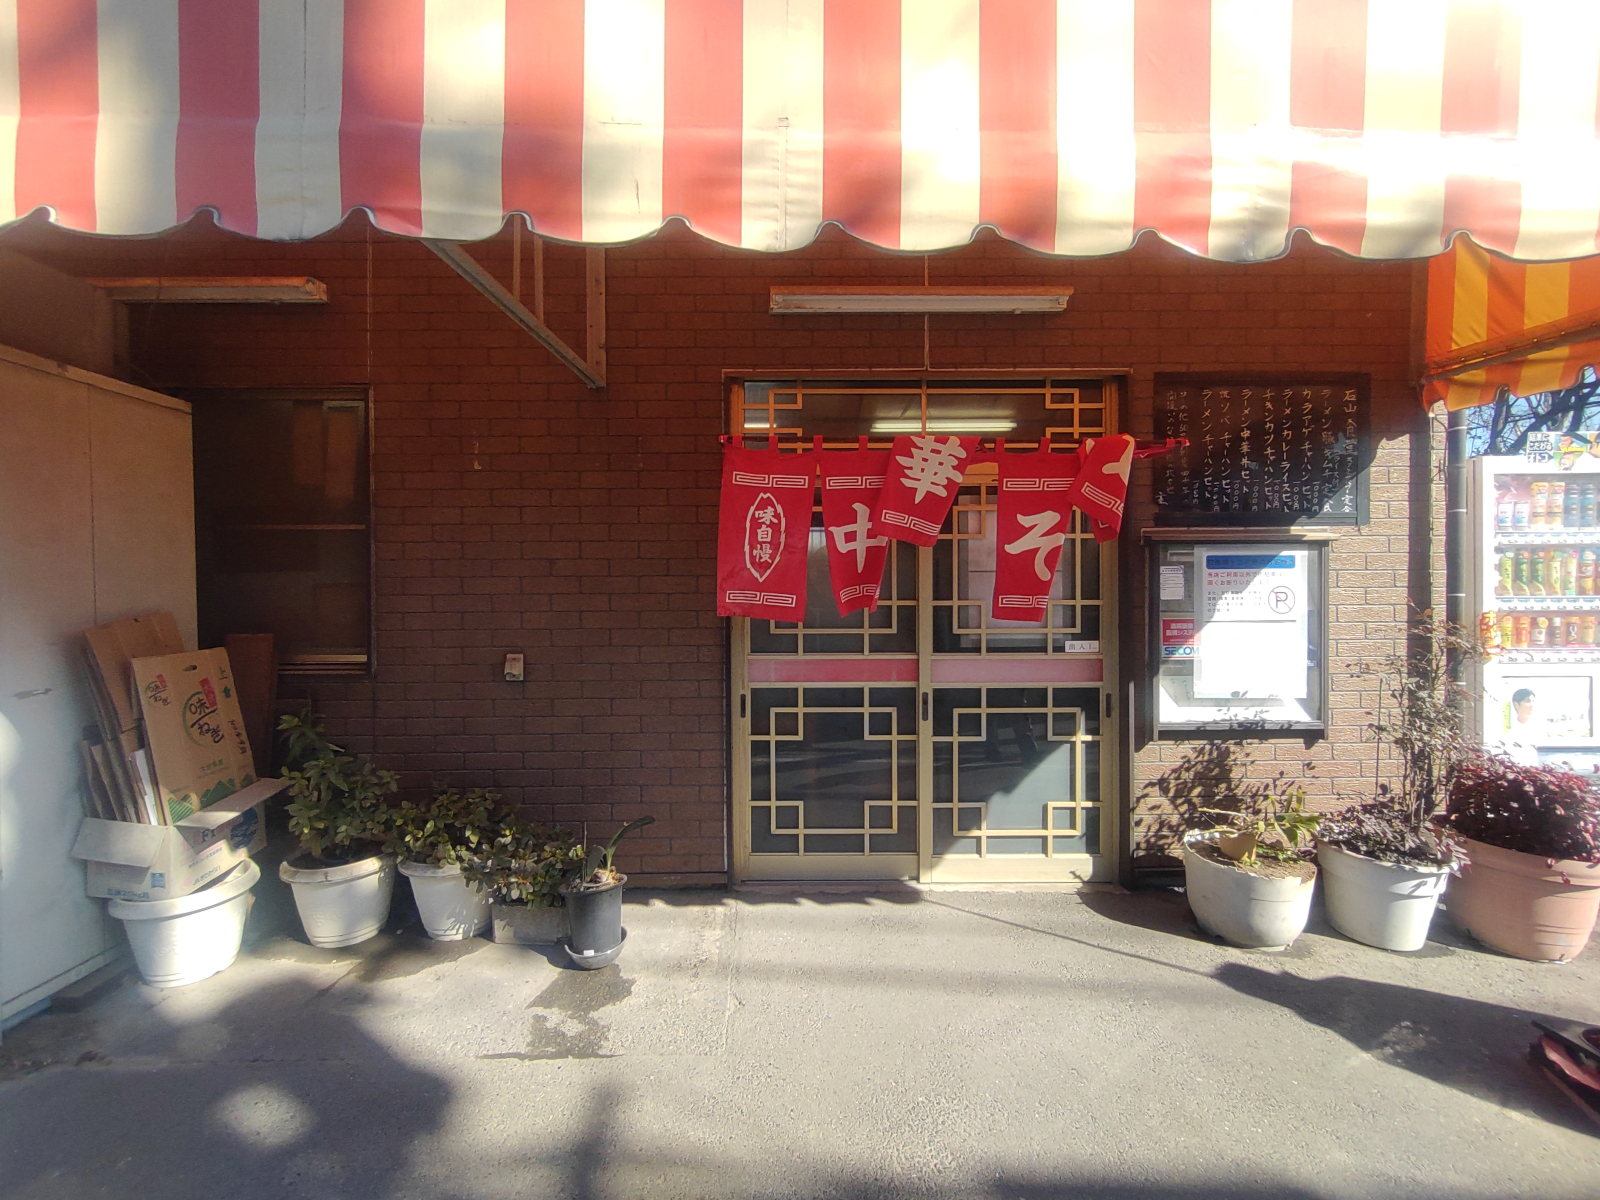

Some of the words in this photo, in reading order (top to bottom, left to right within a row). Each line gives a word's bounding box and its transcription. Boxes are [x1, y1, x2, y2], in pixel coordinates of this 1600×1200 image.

[1527, 452, 1549, 463] オトコ
[753, 505, 778, 563] 味自慢
[1164, 646, 1200, 656] SECOM
[188, 696, 225, 744] 味ねぎ
